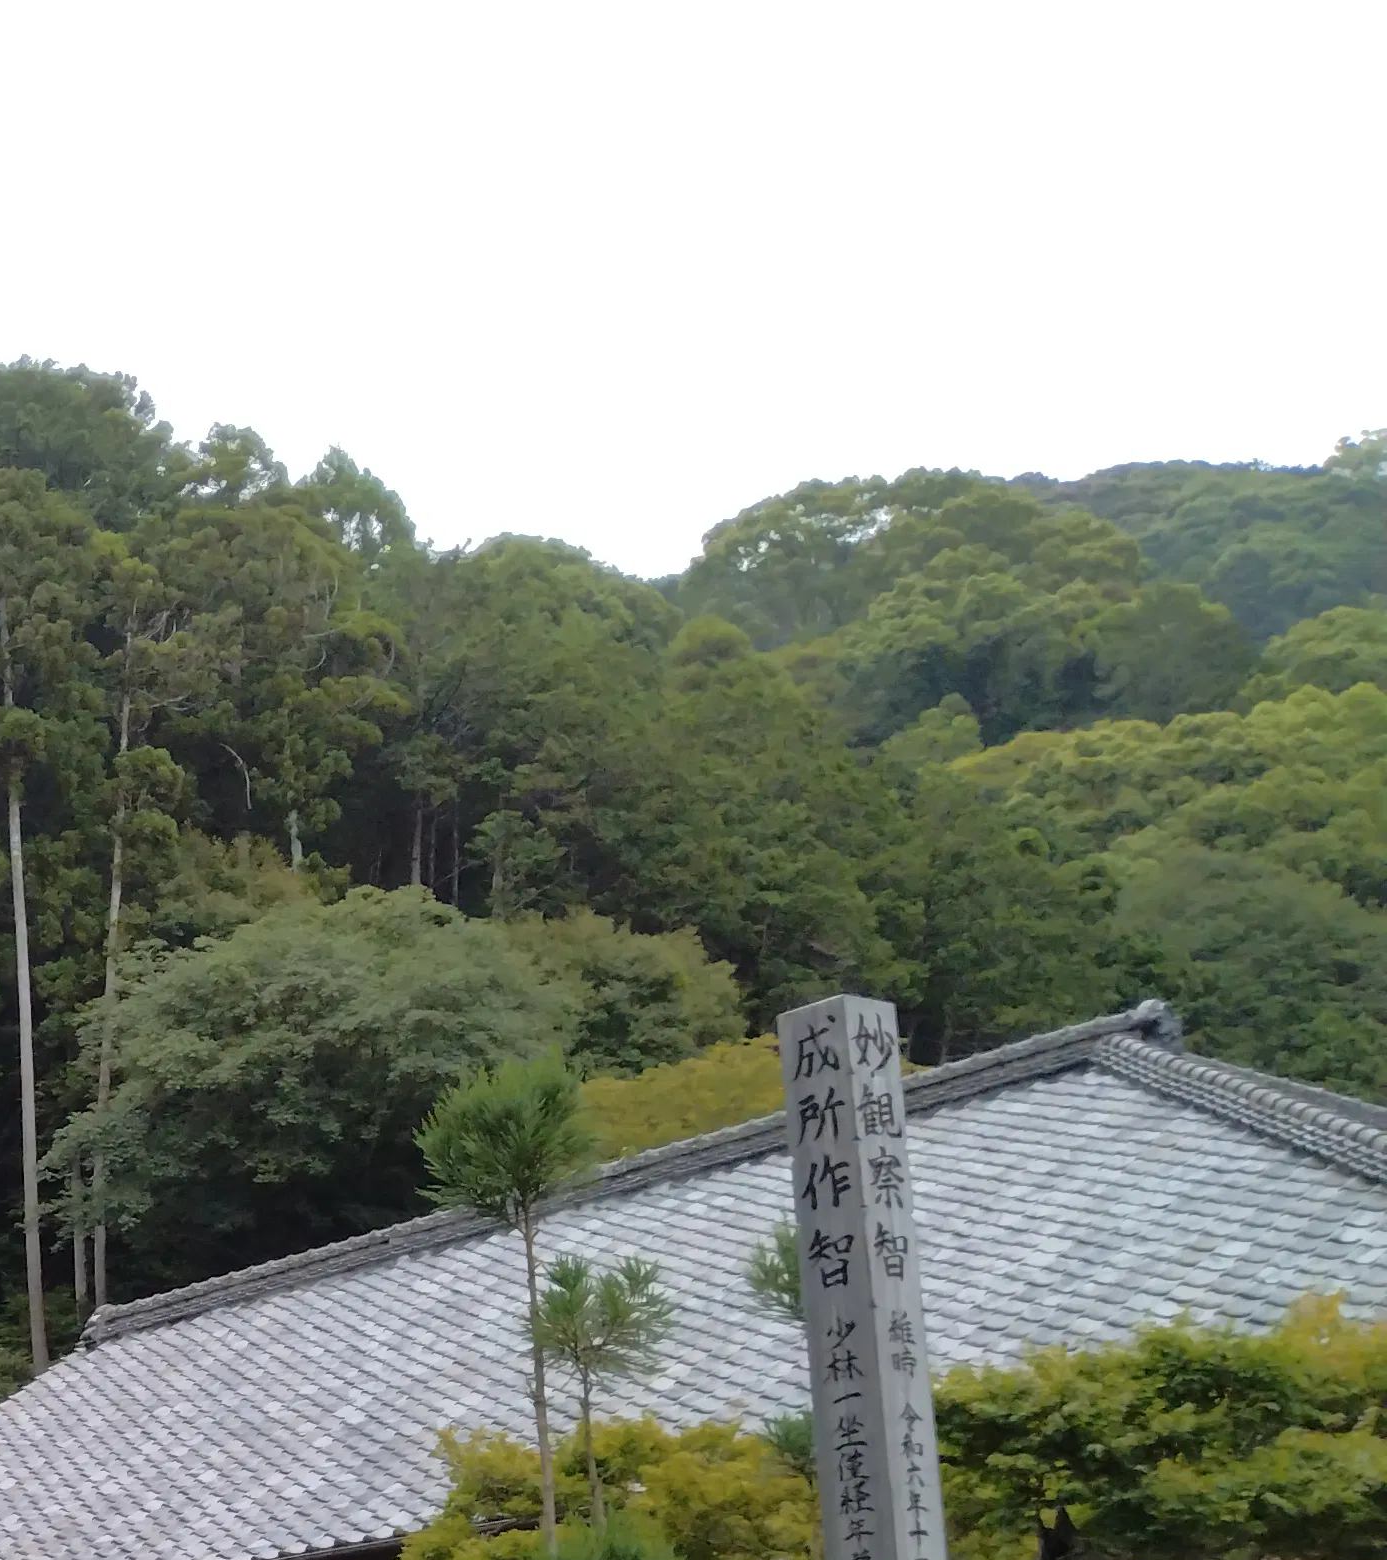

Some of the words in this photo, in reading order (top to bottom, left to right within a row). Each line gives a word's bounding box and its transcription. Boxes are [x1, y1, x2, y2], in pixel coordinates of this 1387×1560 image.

[794, 1014, 854, 1289] 成所作智
[852, 1012, 907, 1280] 妙観察智
